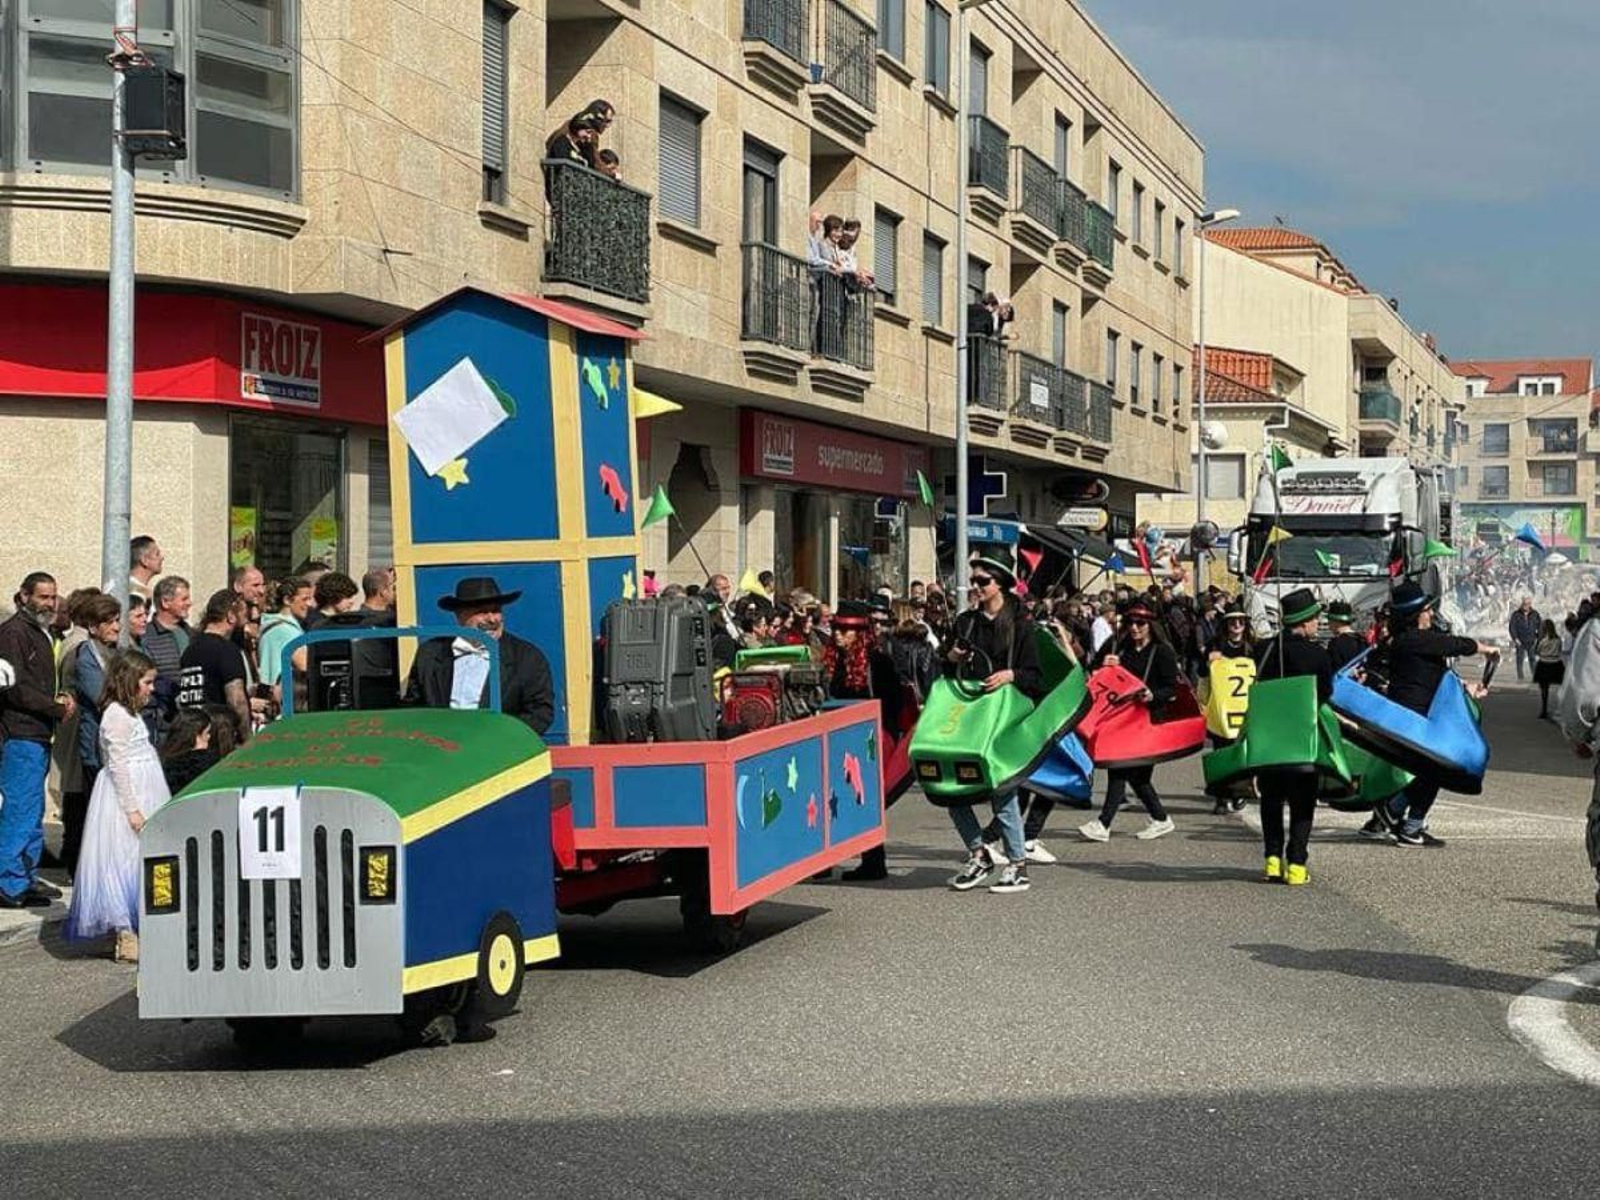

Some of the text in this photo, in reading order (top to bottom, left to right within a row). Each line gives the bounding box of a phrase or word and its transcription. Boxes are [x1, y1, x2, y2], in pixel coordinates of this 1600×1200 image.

[244, 316, 319, 379] FROIZ
[763, 421, 793, 457] FROIZ
[818, 445, 885, 475] supermercado
[1283, 494, 1360, 513] Daniel
[1228, 675, 1248, 697] 2
[252, 805, 285, 853] 11
